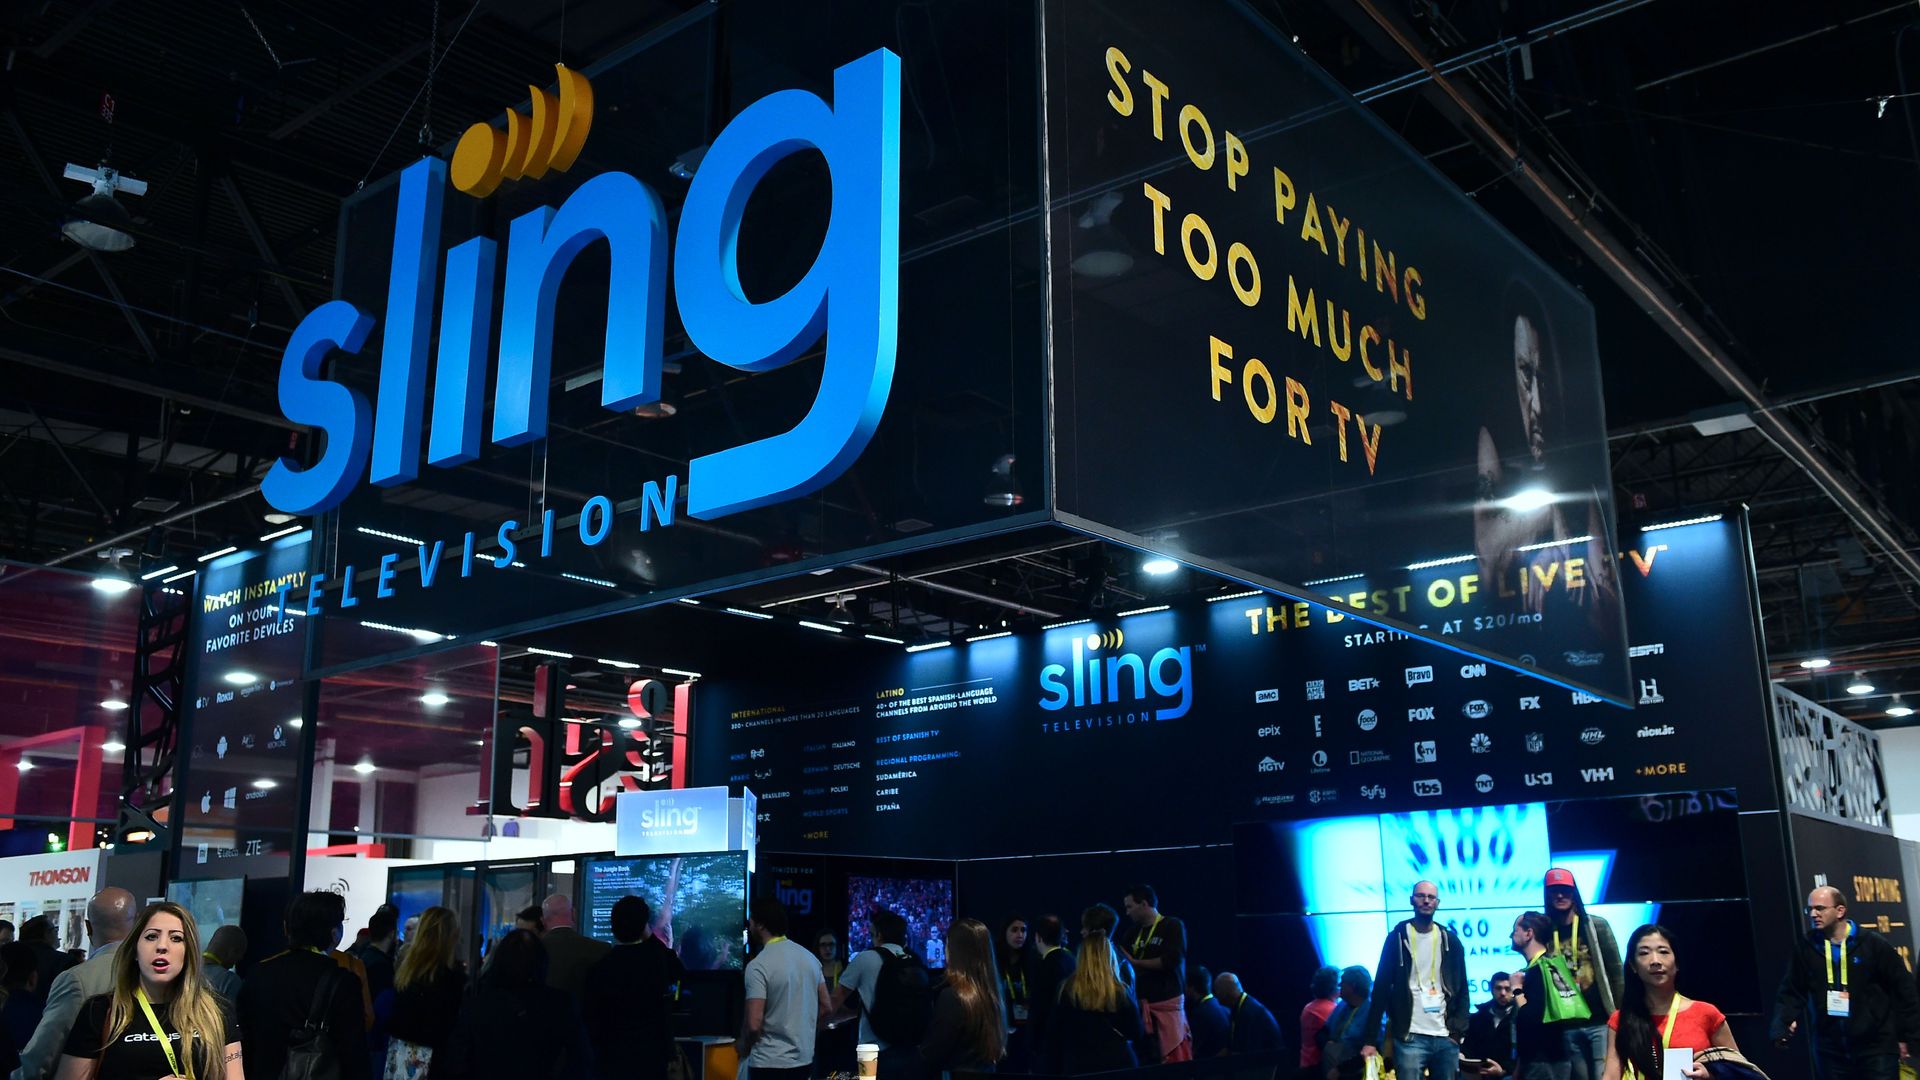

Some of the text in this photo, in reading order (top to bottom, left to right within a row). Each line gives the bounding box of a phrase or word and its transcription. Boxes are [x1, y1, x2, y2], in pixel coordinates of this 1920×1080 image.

[1105, 47, 1426, 320] STOP PAYING
[260, 47, 901, 518] sling
[1144, 182, 1413, 400] TOO MUCH
[1209, 335, 1382, 476] FOR TV
[276, 475, 678, 624] TELEVISION
[203, 571, 306, 614] WATCH INSTANTLY
[1245, 602, 1311, 635] THE
[1326, 586, 1411, 624] BEST
[1427, 574, 1480, 608] OF
[1498, 558, 1587, 598] LIVE
[228, 604, 273, 629] ON YOUR
[1442, 619, 1463, 635] AT
[1473, 612, 1543, 632] $20/mo
[205, 618, 295, 654] FAVORITE DEVICES
[1628, 643, 1664, 658] ESPN
[1038, 633, 1193, 721] sling
[1407, 670, 1431, 681] Bravo
[1460, 663, 1487, 679] CNN
[1348, 677, 1374, 692] BET
[876, 688, 905, 699] LATINO
[899, 699, 911, 707] THE
[912, 697, 928, 706] BEST
[928, 687, 994, 703] SPANISH-LANGUAGE
[876, 696, 998, 719] CHANNELS FROM AROUND THE WORLD
[1519, 696, 1541, 710] FX
[731, 706, 785, 720] INTERNATIONAL
[745, 719, 774, 728] CHANNELS
[817, 711, 824, 719] 20
[825, 706, 860, 718] LANGUAGES
[1359, 713, 1377, 726] food
[1408, 707, 1435, 722] FOX
[1042, 711, 1150, 734] TELEVISION
[876, 736, 891, 744] BEST
[902, 731, 929, 740] SPANISH
[930, 729, 940, 737] TV
[1258, 724, 1281, 738] epix
[831, 740, 856, 749] ITALIANO
[1472, 746, 1491, 754] NBC
[833, 761, 860, 771] DEUTSCHE
[876, 757, 908, 766] REGIONAL
[1258, 761, 1285, 772] HGTV
[876, 771, 917, 782] SUDAMÉRICA
[762, 791, 790, 800] BRASILEIRO
[830, 785, 848, 793] POLSKI
[876, 788, 899, 797] CARIBE
[1360, 785, 1387, 800] Syfy
[1415, 782, 1440, 794] tbs
[876, 802, 901, 812] ESPAÑA
[641, 799, 700, 835] sling
[757, 813, 771, 822] 中文
[245, 840, 262, 857] ZTE
[29, 866, 91, 887] THOMSON
[1853, 875, 1875, 903] STOP
[775, 879, 813, 915] ling
[1447, 918, 1489, 938] $60
[124, 1031, 188, 1043] catays
